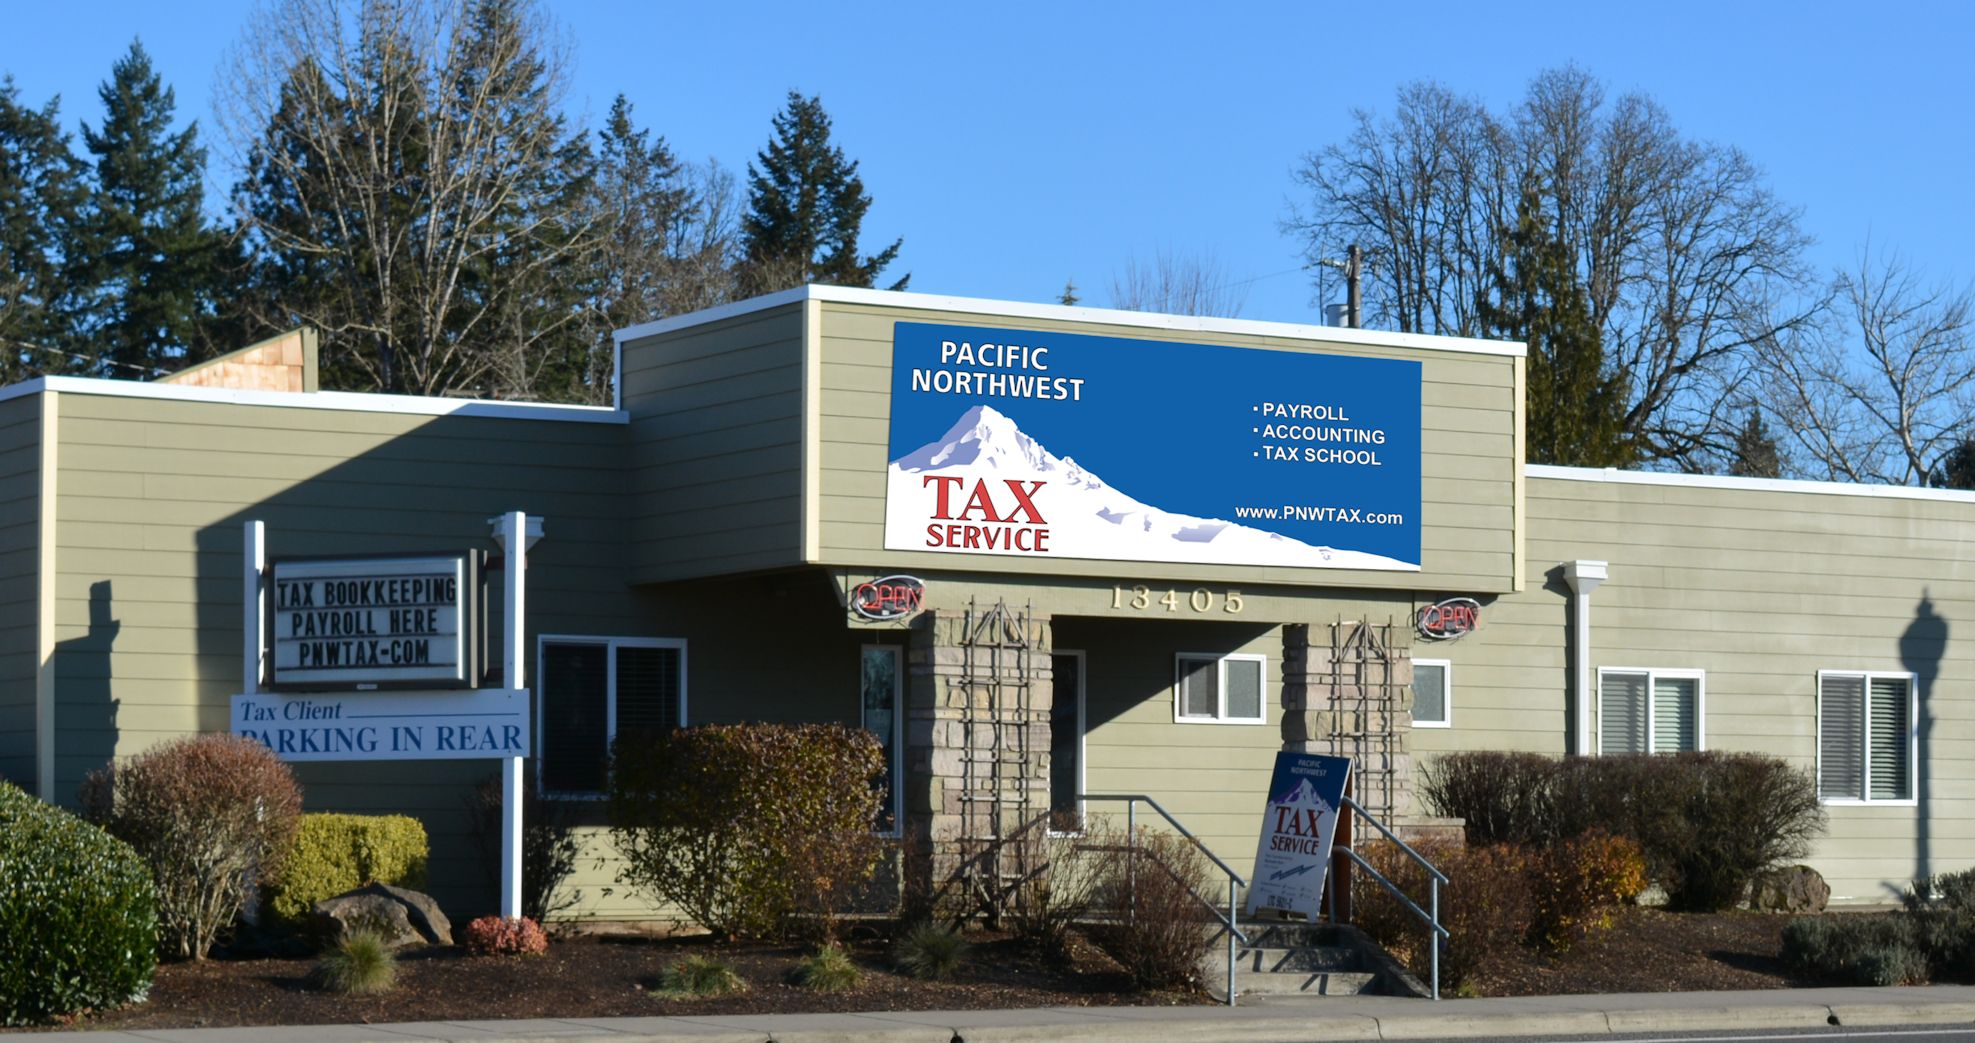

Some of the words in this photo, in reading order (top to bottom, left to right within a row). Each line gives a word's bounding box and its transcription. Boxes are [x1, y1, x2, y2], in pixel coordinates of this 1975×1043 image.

[941, 340, 1049, 371] PACIFIC
[911, 368, 1085, 401] NORTHWEST
[1262, 402, 1350, 421] PAYROLL
[1262, 423, 1386, 445] ACCOUNTING
[1263, 445, 1299, 461] TAX
[1304, 447, 1382, 466] SCHOOL
[923, 475, 1048, 525] TAX
[1235, 505, 1403, 525] www.PNWTAX.com
[926, 523, 1049, 552] SERVICE
[277, 582, 314, 606] TAX
[325, 577, 456, 605] BOOKKEEPING
[857, 583, 926, 612] OPEN
[1111, 584, 1244, 613] 13405
[292, 610, 377, 636] PAYROLL
[389, 608, 438, 633] HERE
[1424, 605, 1483, 631] OPEN
[300, 639, 429, 666] PNWTAX-COM
[241, 701, 277, 721] Tax
[283, 700, 342, 720] Client
[391, 726, 423, 751] IN
[435, 725, 523, 751] REAR
[1290, 766, 1327, 777] NORTHWEST
[1297, 759, 1322, 768] PACIFIC
[1274, 805, 1325, 838] TAX
[1270, 835, 1319, 855] SERVICE
